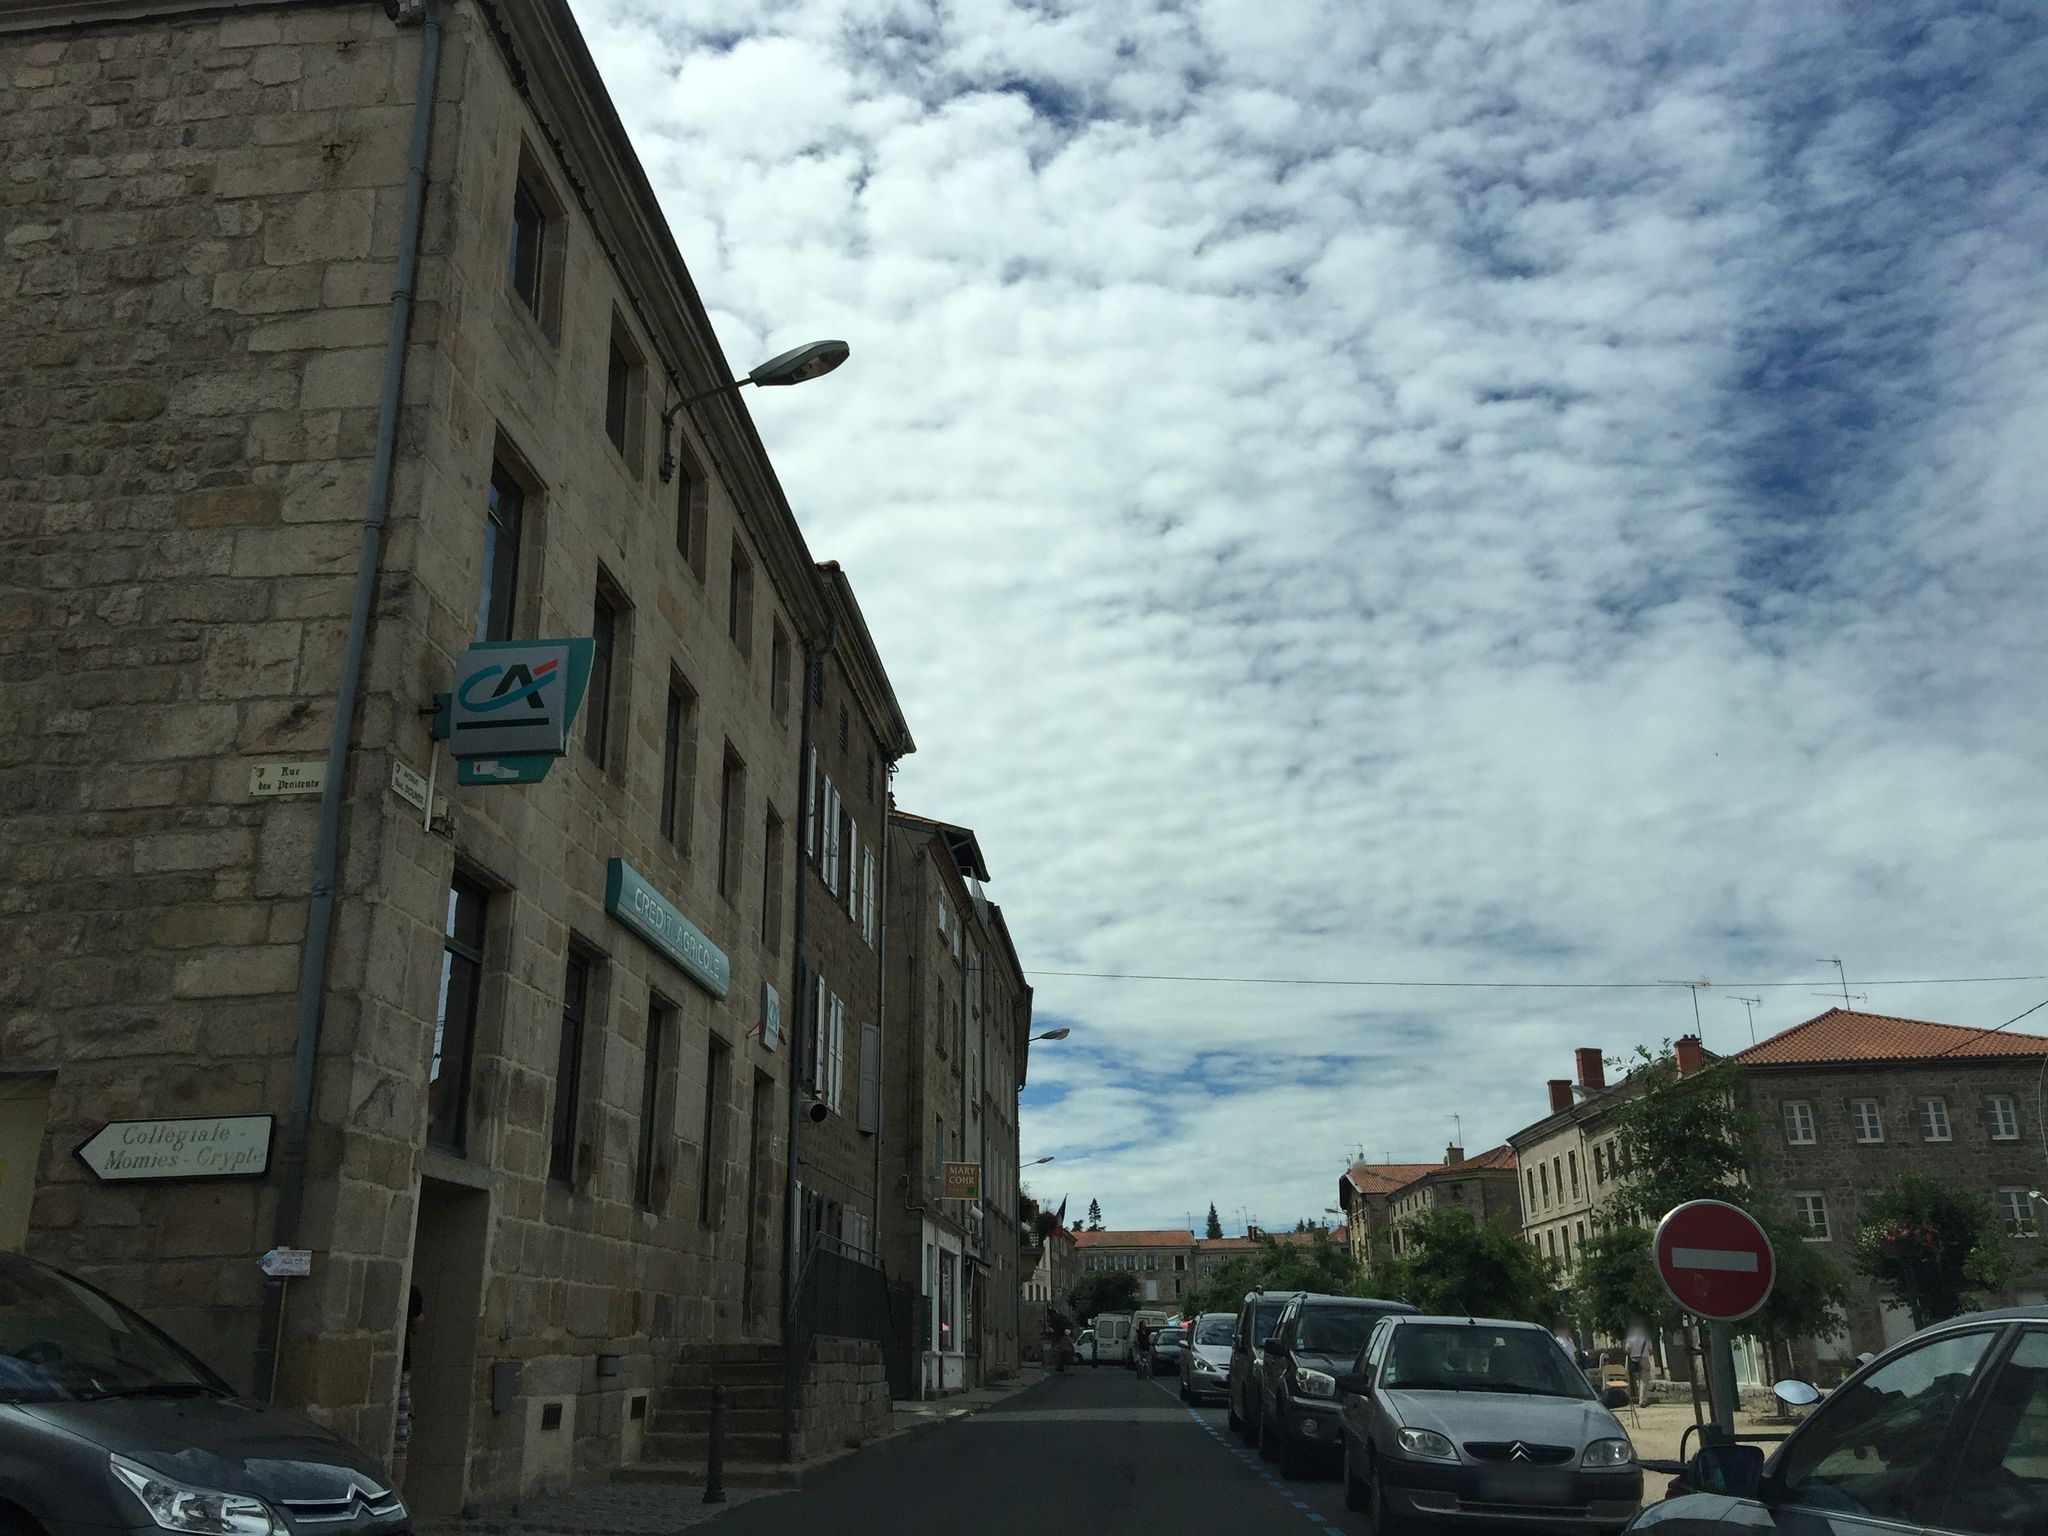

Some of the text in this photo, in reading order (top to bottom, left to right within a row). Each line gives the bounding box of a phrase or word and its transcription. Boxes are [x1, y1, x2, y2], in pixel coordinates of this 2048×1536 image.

[281, 766, 301, 777] Rue
[258, 781, 271, 791] des
[676, 926, 720, 979] AGRICOLE
[104, 1149, 180, 1171] Momies
[949, 1166, 976, 1176] MARY
[949, 1175, 975, 1185] COHR
